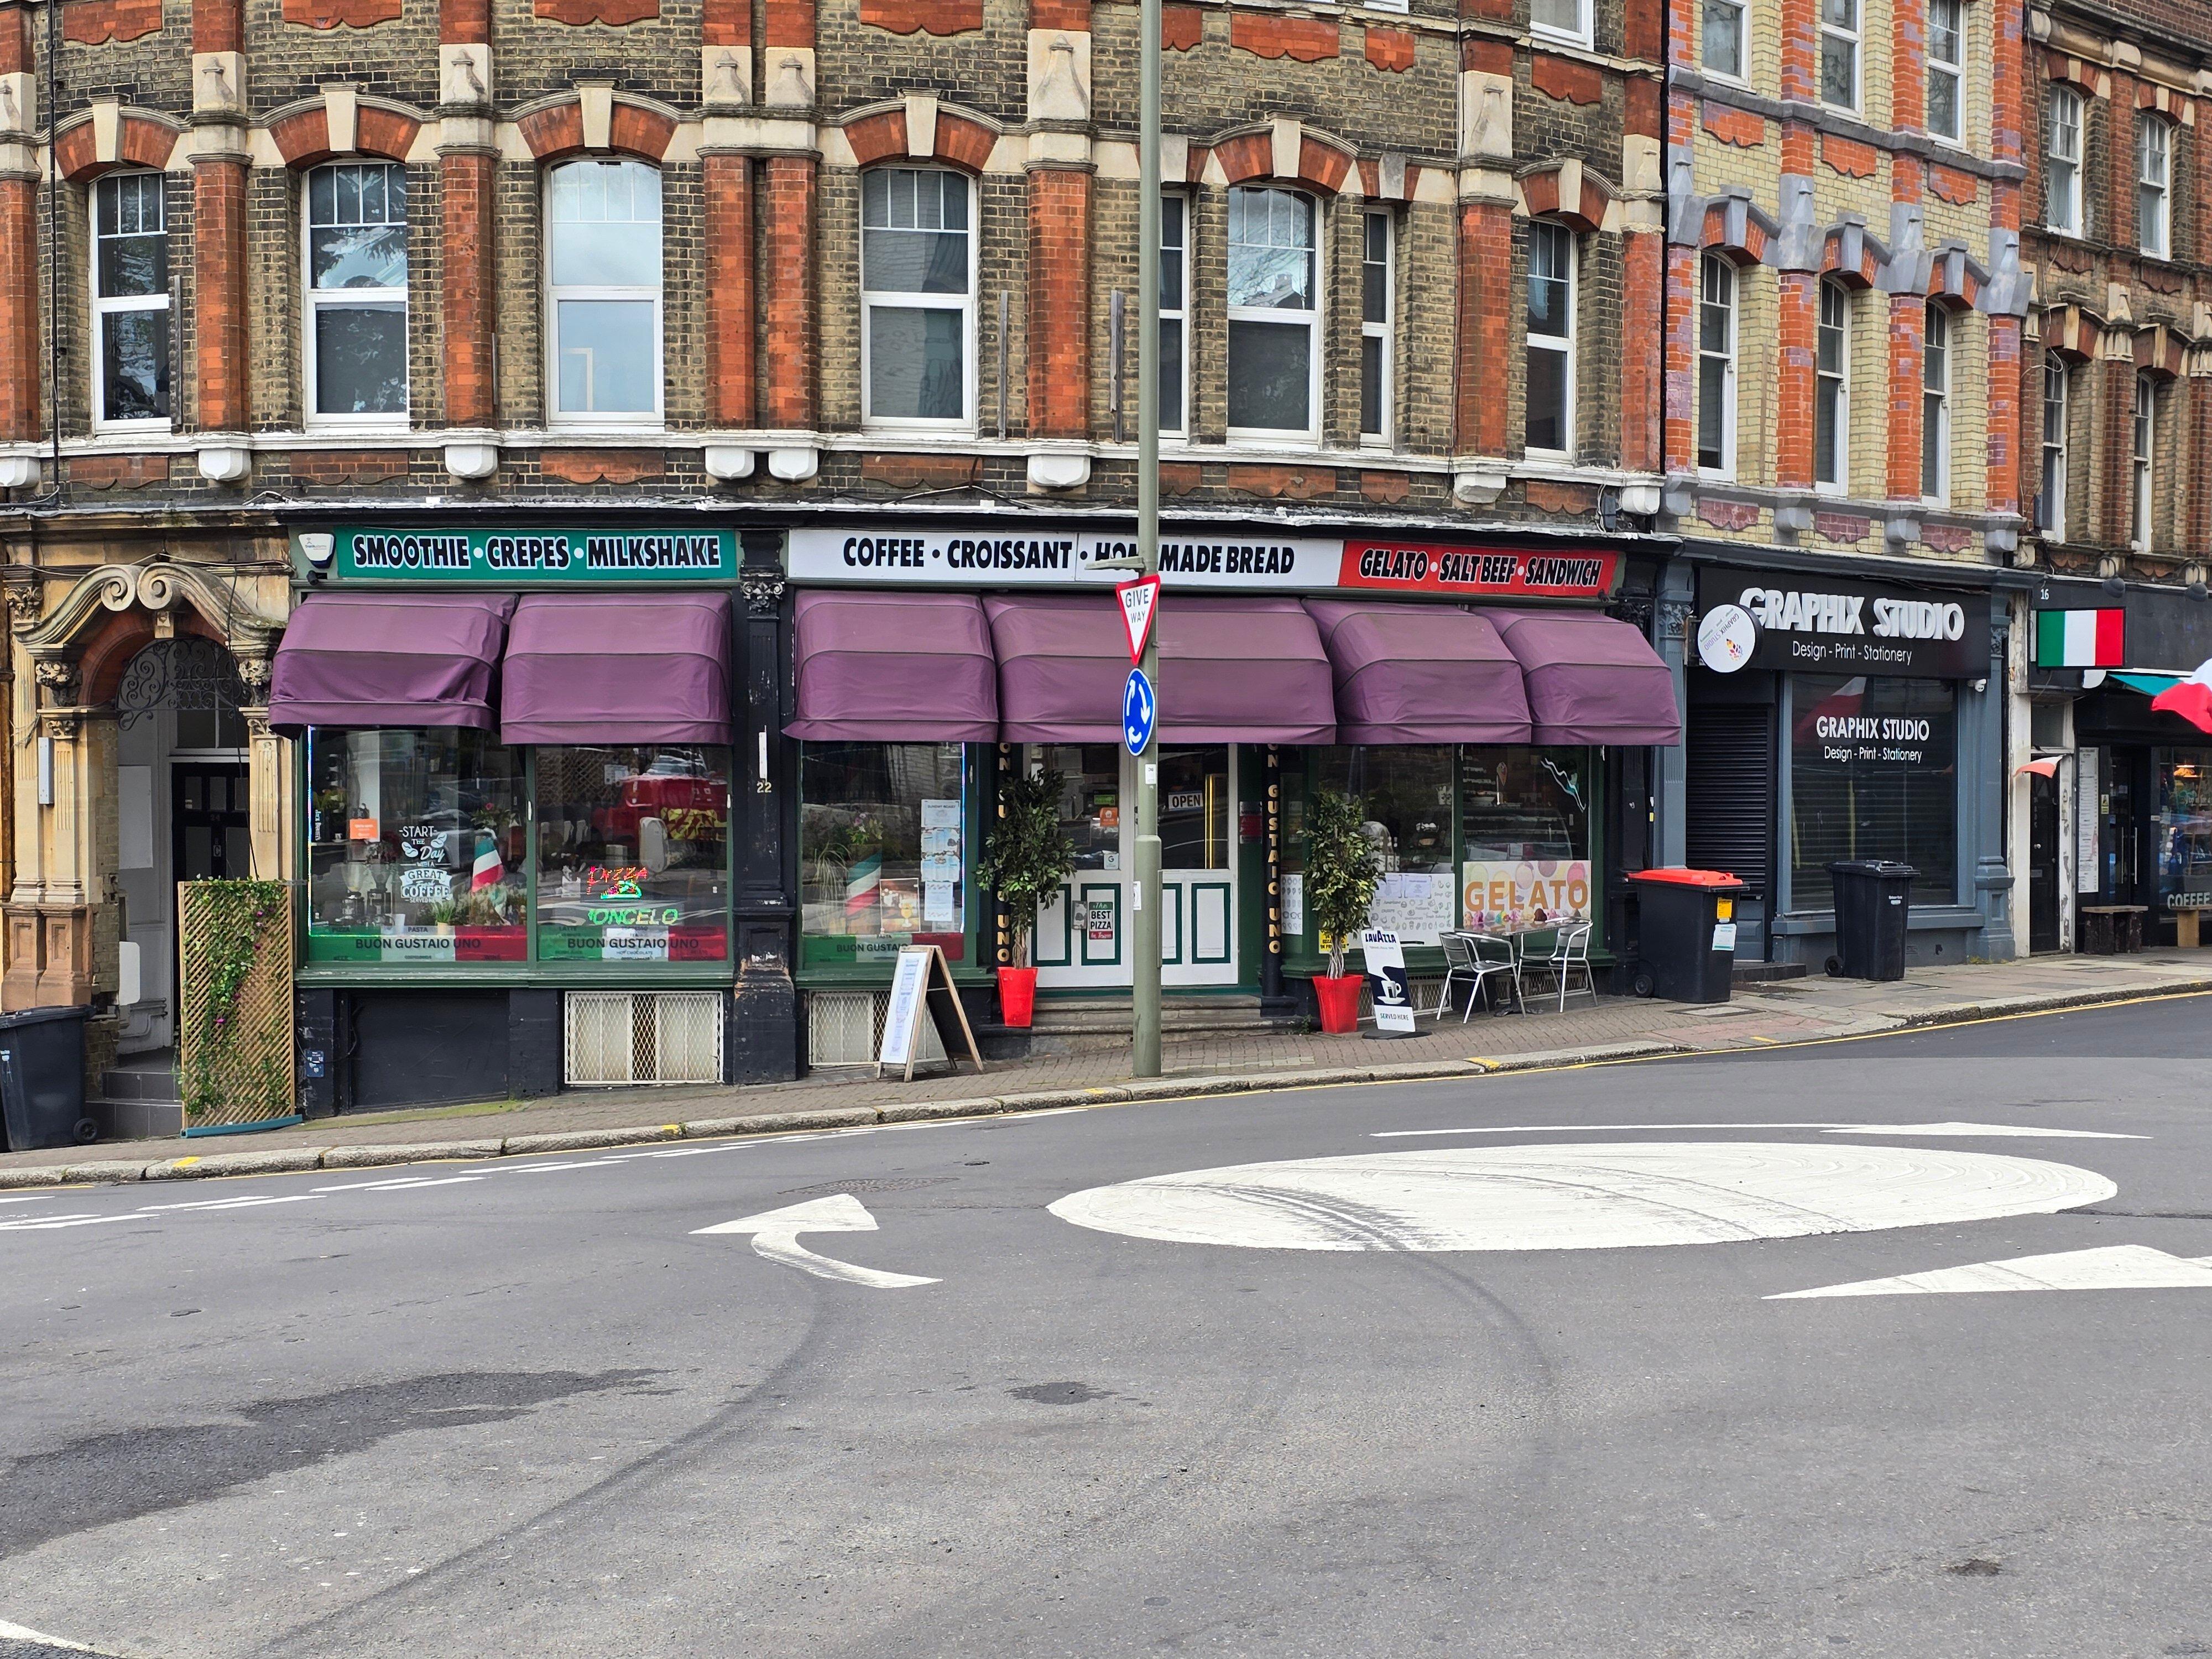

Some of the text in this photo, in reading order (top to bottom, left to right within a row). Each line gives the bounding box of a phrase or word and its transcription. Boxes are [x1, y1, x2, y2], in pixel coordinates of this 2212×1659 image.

[353, 534, 722, 570] SMOOTHIE CREPES MILKSHAKE
[843, 538, 925, 567] COFFEE
[947, 540, 1072, 569] CROISSANT
[1225, 546, 1295, 573] BREAD
[1359, 548, 1603, 587] GELATO SALT BEEF SANDWICH
[1125, 588, 1149, 608] GIVE
[2041, 588, 2049, 600] 16
[1131, 611, 1145, 623] WAY
[1739, 587, 1965, 641] GRAPHIX STUDIO
[1704, 613, 1740, 650] GRAPHIX STUDIO
[1793, 641, 1912, 666] Design Print Stationery
[1816, 716, 1930, 741] GRAPHIX STUDIO
[1824, 745, 1922, 764] Design Print Stationery
[757, 781, 772, 793] 22
[1172, 794, 1201, 808] OPEN
[402, 826, 435, 838] START
[1267, 784, 1280, 895] GUSTAIO
[420, 846, 445, 863] Day
[408, 870, 444, 880] GREAT
[402, 885, 450, 898] COFFEE
[1465, 879, 1589, 912] GELATO
[1091, 910, 1112, 920] BEST
[1091, 921, 1112, 930] PIZZA
[1269, 907, 1281, 954] UNO
[356, 938, 482, 949] BUON GUSTAIO UNO
[567, 938, 699, 949] BUON GUSTAIO UNO
[997, 914, 1010, 962] UNO
[1365, 930, 1397, 943] LAVAZZA
[836, 943, 864, 953] BUON
